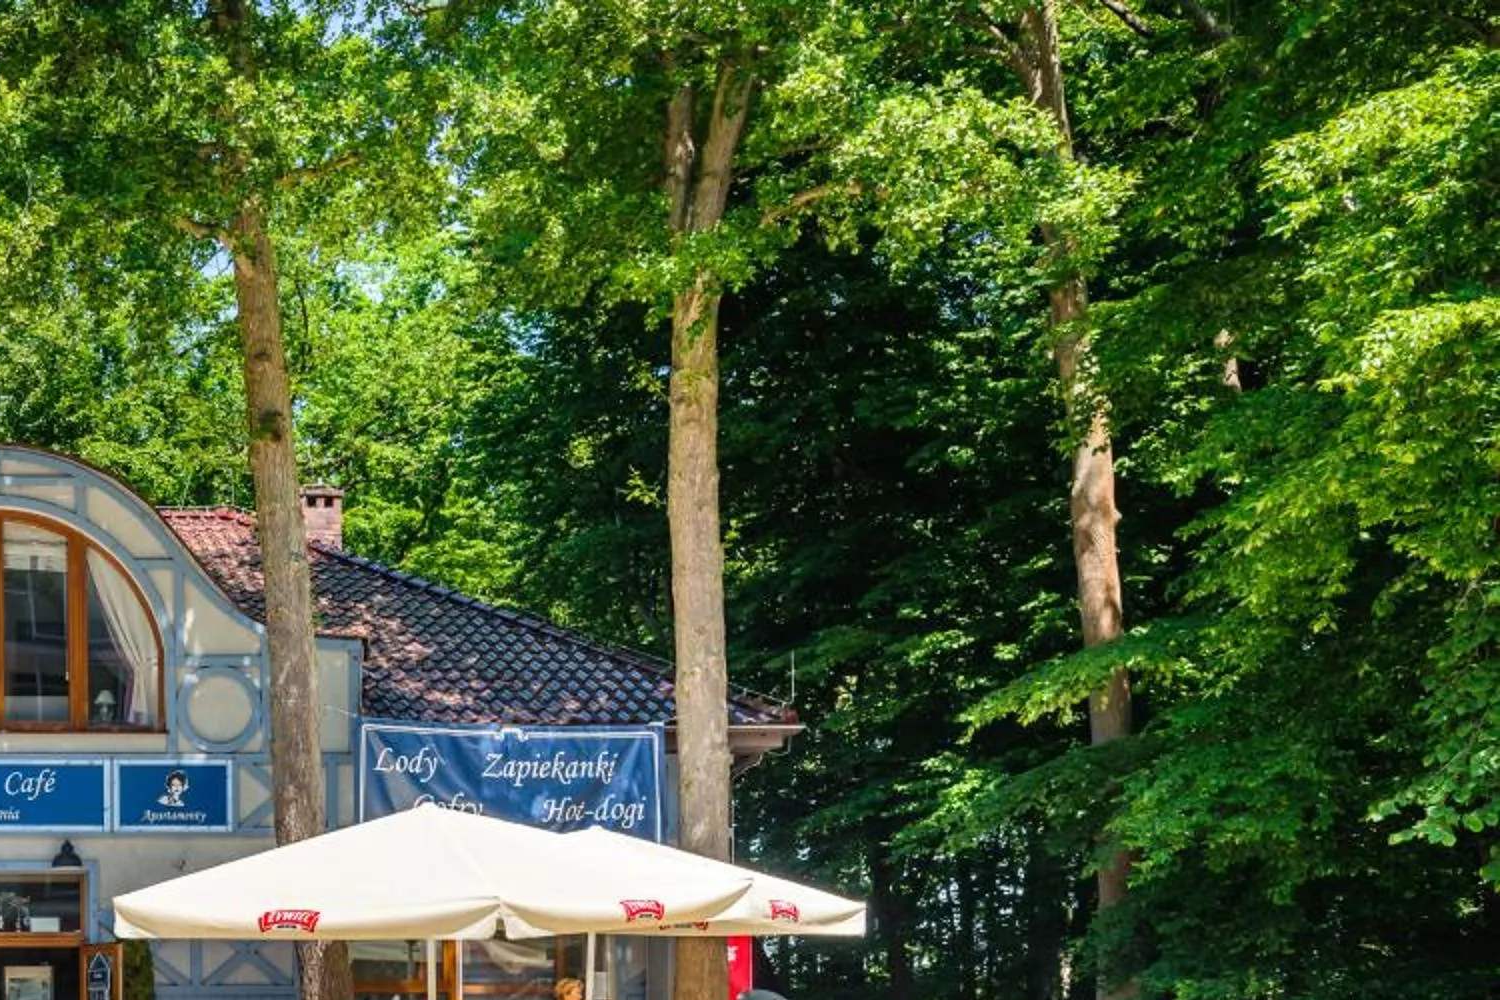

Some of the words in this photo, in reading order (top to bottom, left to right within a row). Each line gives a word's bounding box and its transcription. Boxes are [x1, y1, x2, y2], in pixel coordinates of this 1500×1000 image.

[372, 747, 439, 783] Lody
[482, 751, 618, 786] Zapiekanki
[4, 769, 57, 800] Café
[141, 809, 207, 823] Apartamenty
[542, 795, 647, 830] Hot-dogi
